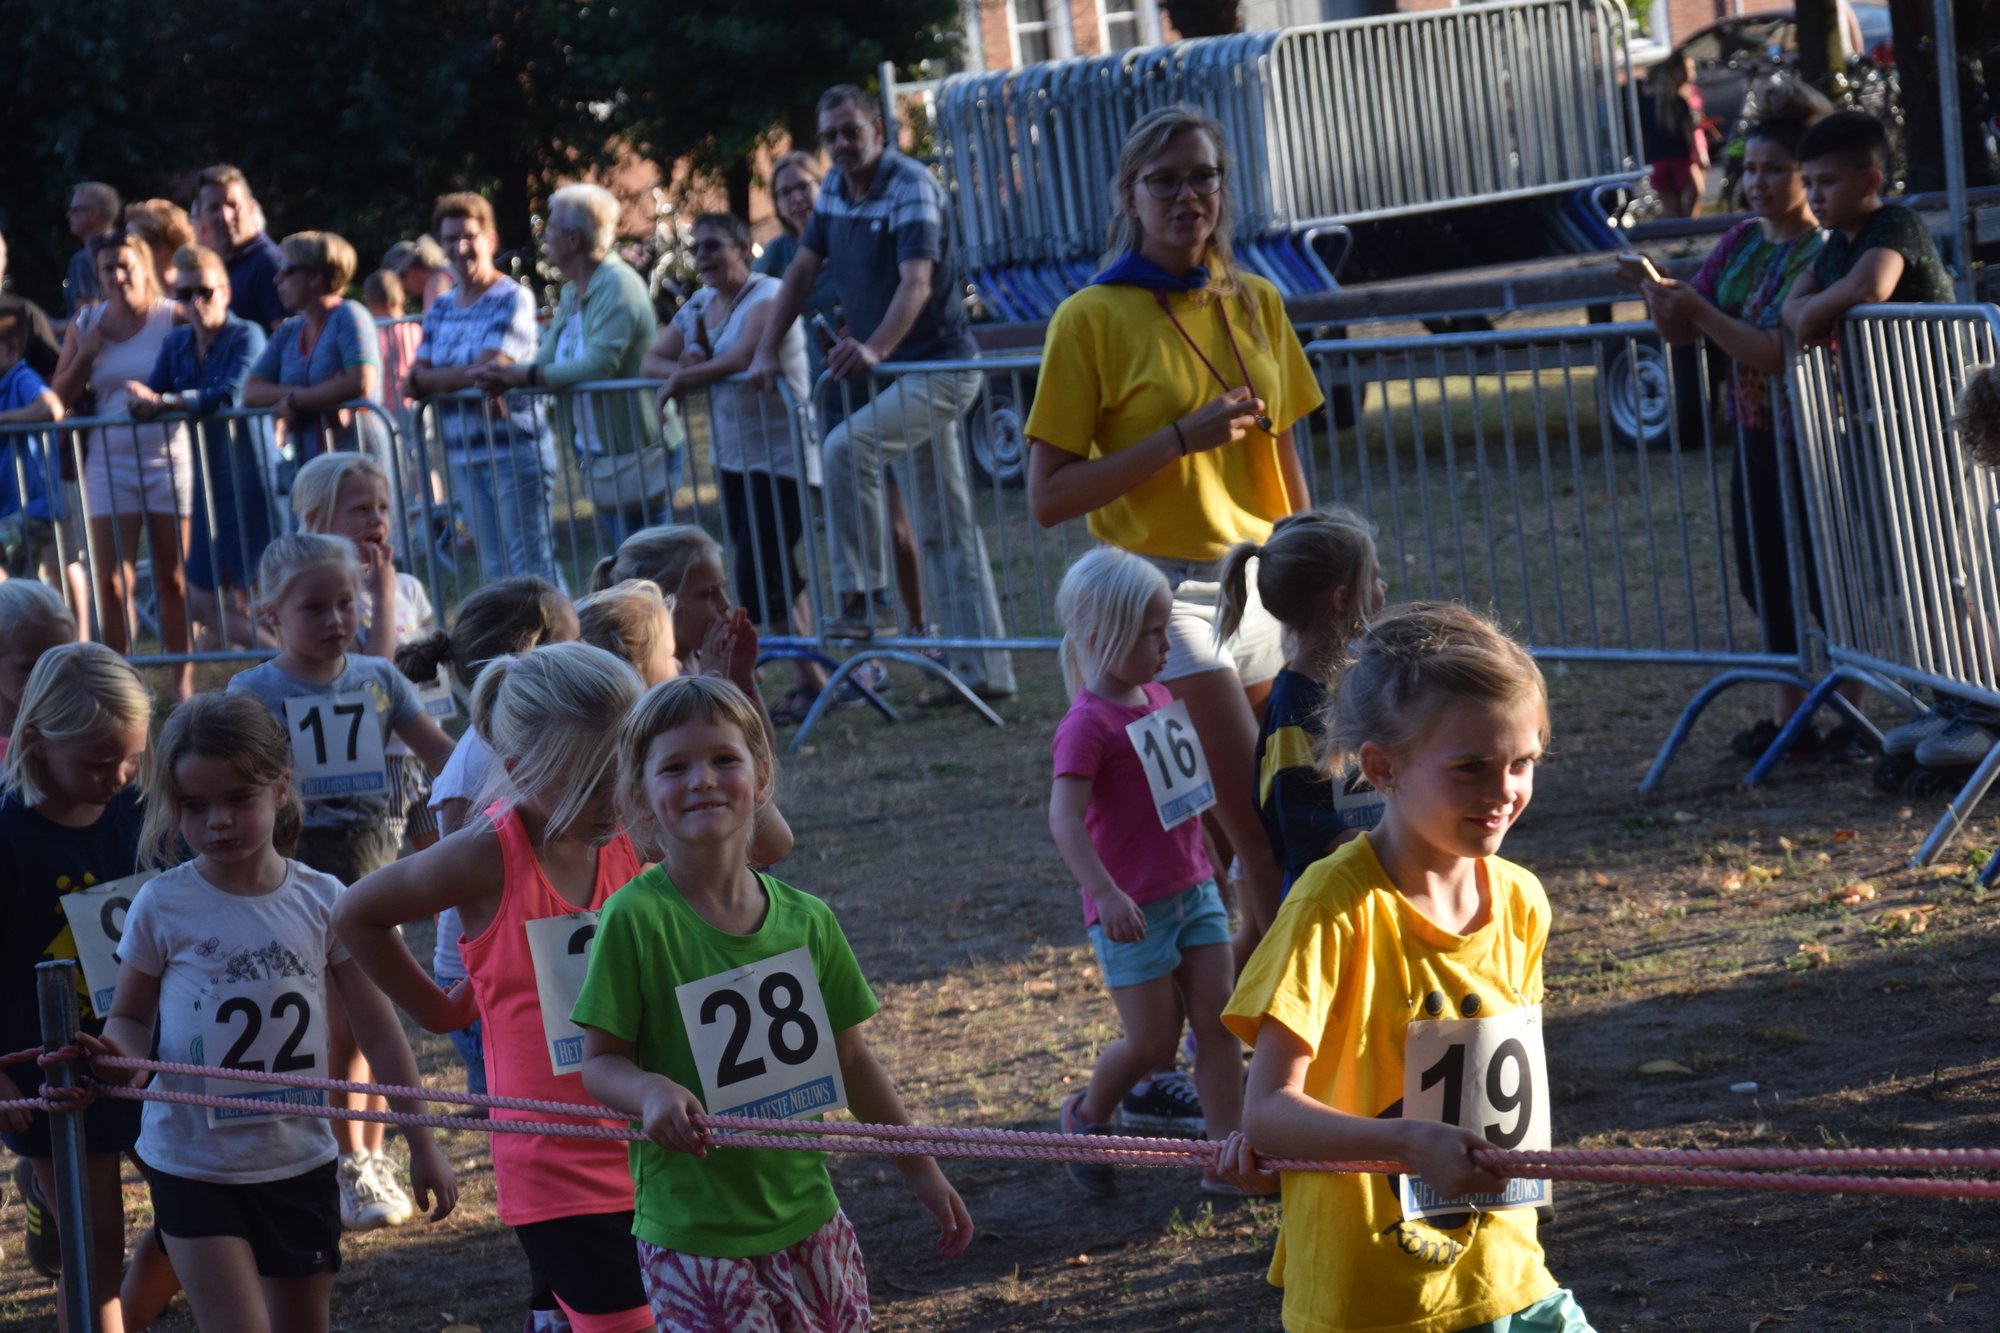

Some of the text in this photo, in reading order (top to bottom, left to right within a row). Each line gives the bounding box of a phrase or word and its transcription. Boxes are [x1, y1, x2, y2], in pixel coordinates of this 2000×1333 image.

[299, 703, 365, 765] 17
[1144, 718, 1197, 790] 16
[99, 990, 115, 1010] HE
[216, 992, 316, 1073] 22
[701, 972, 819, 1089] 28
[557, 1040, 581, 1064] HET
[788, 1082, 831, 1113] NIEUWS
[1421, 1038, 1533, 1150] 19
